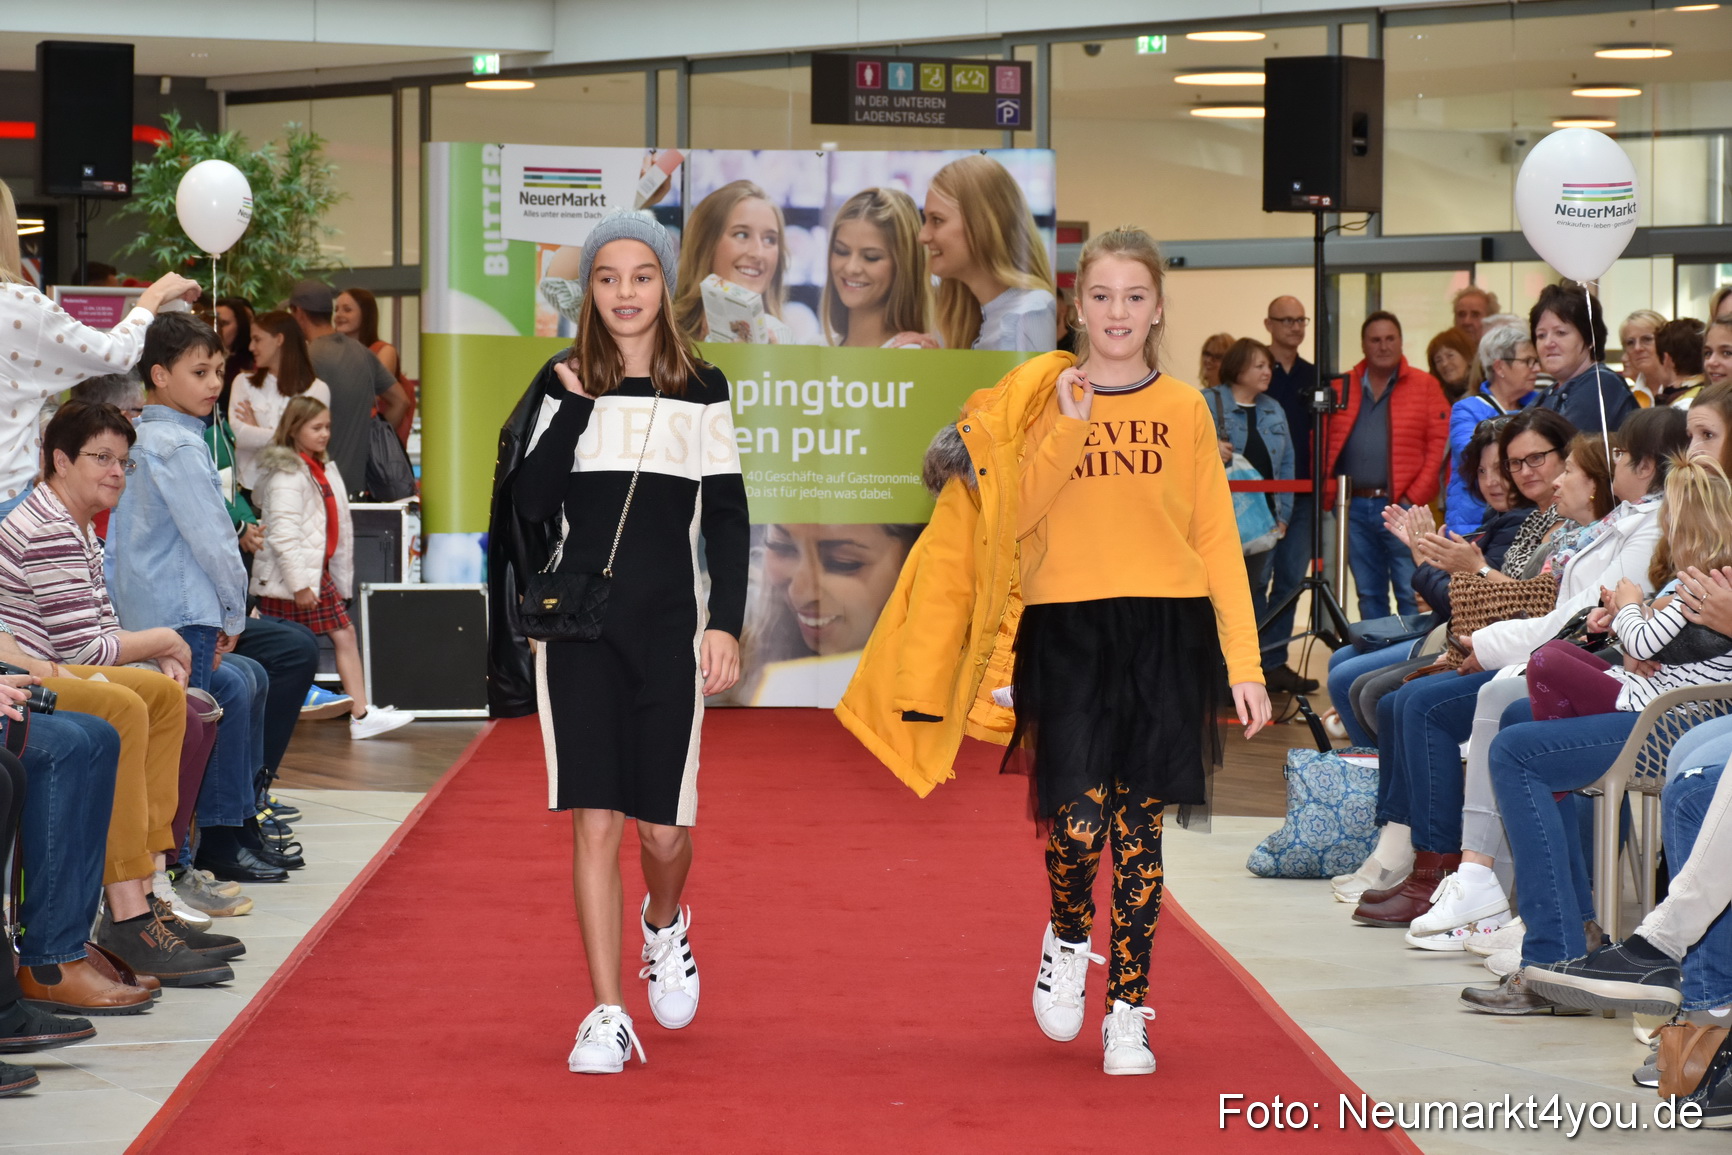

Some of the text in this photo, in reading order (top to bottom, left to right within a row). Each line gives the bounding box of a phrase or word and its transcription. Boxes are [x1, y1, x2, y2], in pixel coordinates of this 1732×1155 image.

[855, 95, 946, 108] IN DER UNTEREN
[855, 111, 946, 124] LADENSTRASSE
[1003, 107, 1014, 123] P
[519, 191, 606, 207] NeuerMarkt
[523, 210, 540, 218] Alles
[584, 211, 602, 219] Dach
[1554, 202, 1637, 218] NeuerMarkt
[1556, 219, 1591, 229] einkaufen
[729, 371, 915, 416] pingtour
[576, 406, 734, 465] UESS
[1084, 420, 1171, 448] EVER
[733, 426, 867, 462] en pur.
[1070, 449, 1163, 480] MIND
[746, 470, 923, 486] 40 Geschäfte auf Gastronomie,
[764, 485, 778, 498] ist
[780, 485, 799, 498] für
[800, 487, 832, 500] jeden
[834, 490, 858, 499] was
[859, 487, 894, 500] dabei.
